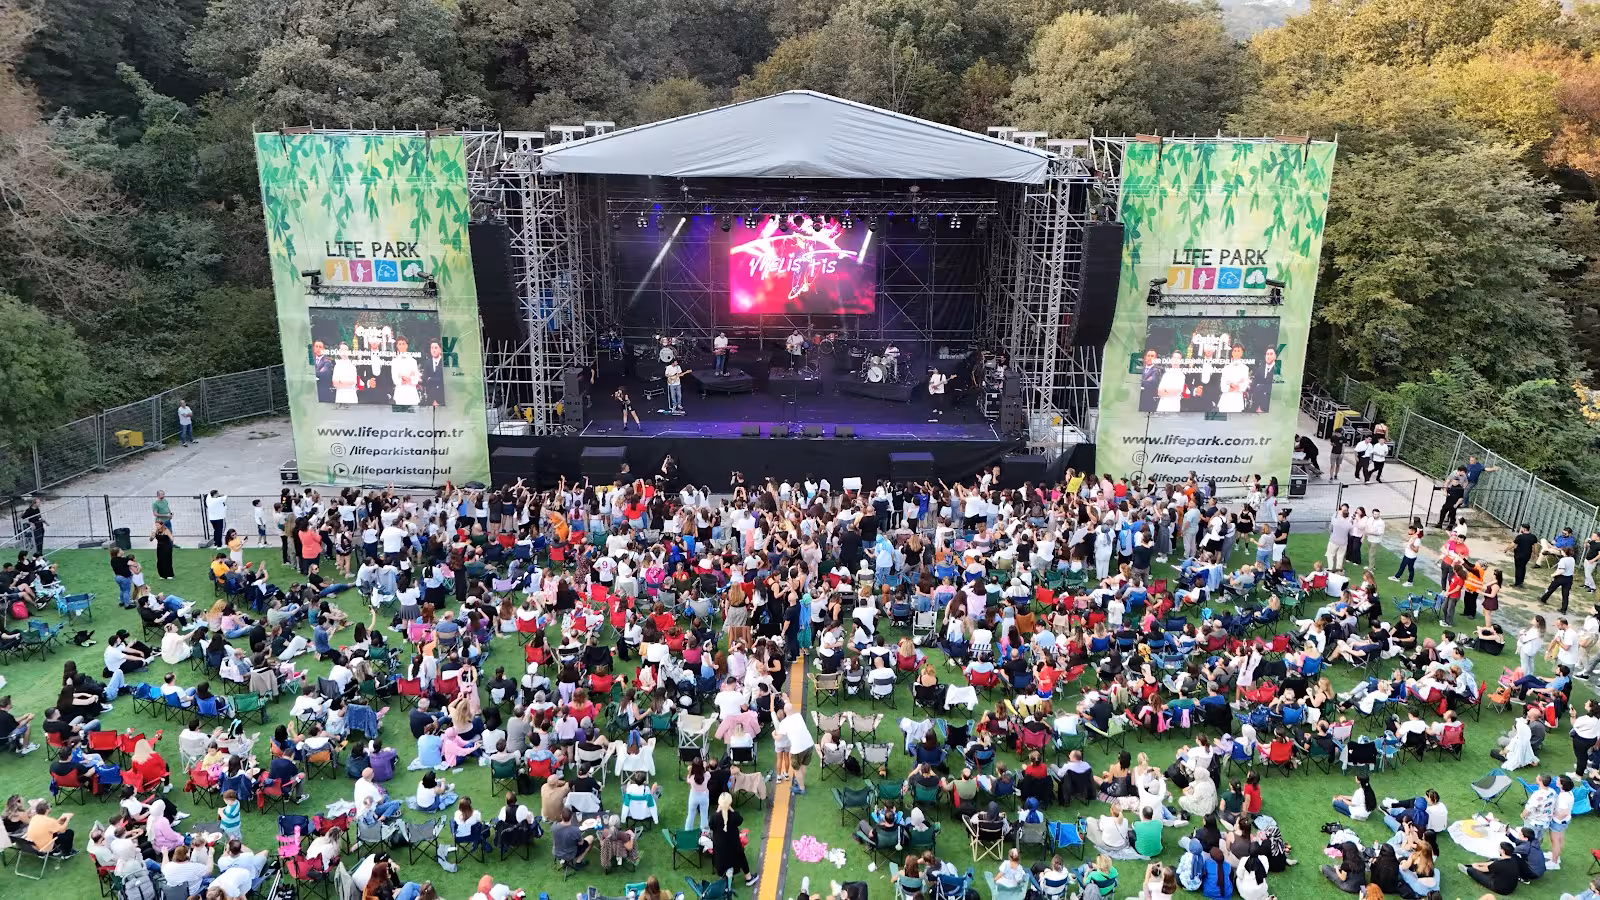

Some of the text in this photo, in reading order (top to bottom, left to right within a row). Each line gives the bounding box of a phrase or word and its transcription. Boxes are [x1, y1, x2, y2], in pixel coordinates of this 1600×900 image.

[325, 241, 420, 258] LIFE PARK
[1172, 248, 1268, 265] LIFE PARK
[317, 427, 464, 439] www.lifepark.com.tr
[1122, 434, 1272, 447] www.lifepark.com.tr
[349, 445, 450, 457] /lifeparkistanbul
[1150, 453, 1254, 465] /lifeparkistanbul
[352, 465, 452, 476] /lifeparkistanbul
[602, 561, 608, 569] 9
